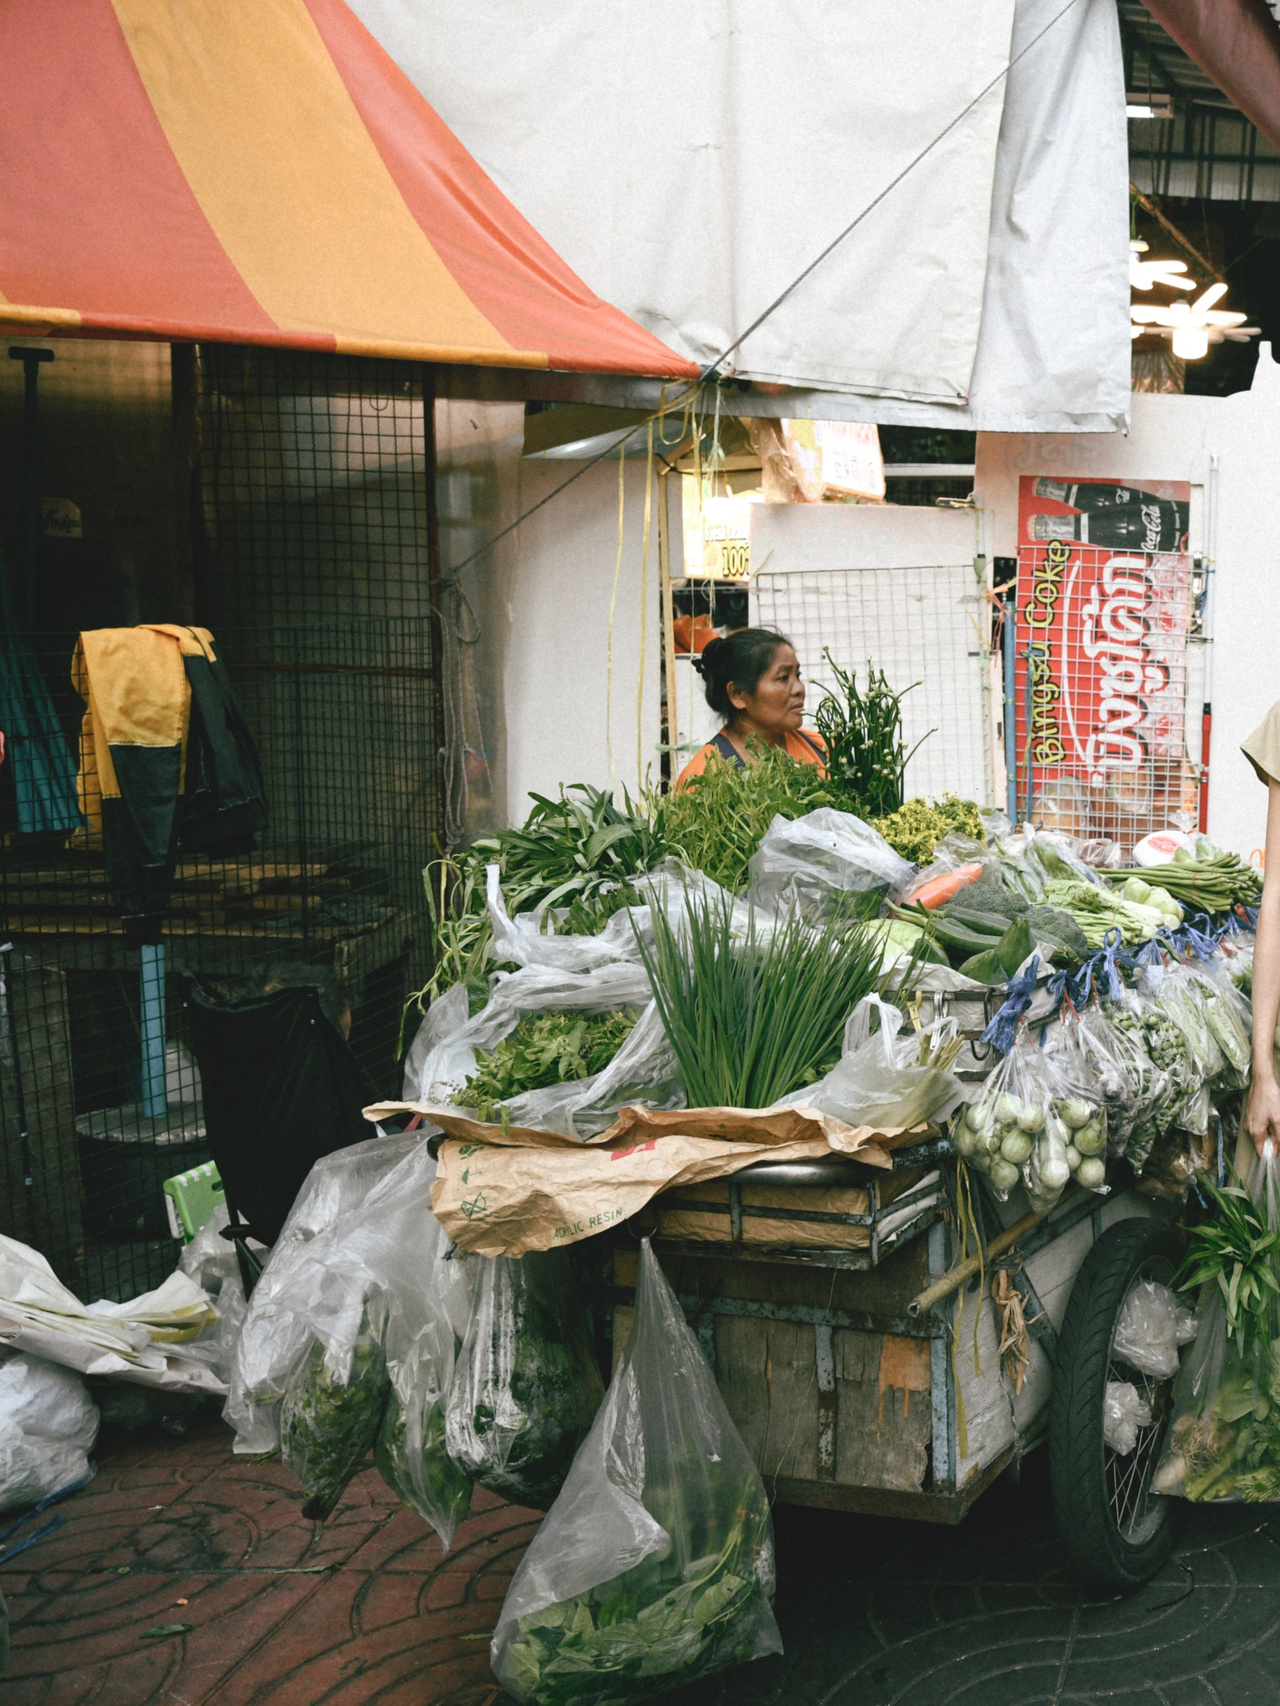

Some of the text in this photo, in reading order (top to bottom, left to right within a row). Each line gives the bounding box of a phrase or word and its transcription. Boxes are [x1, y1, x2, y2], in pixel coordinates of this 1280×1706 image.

[1140, 504, 1162, 551] Coca-Cola
[1023, 540, 1073, 629] Coke
[589, 1207, 623, 1228] RESIN
